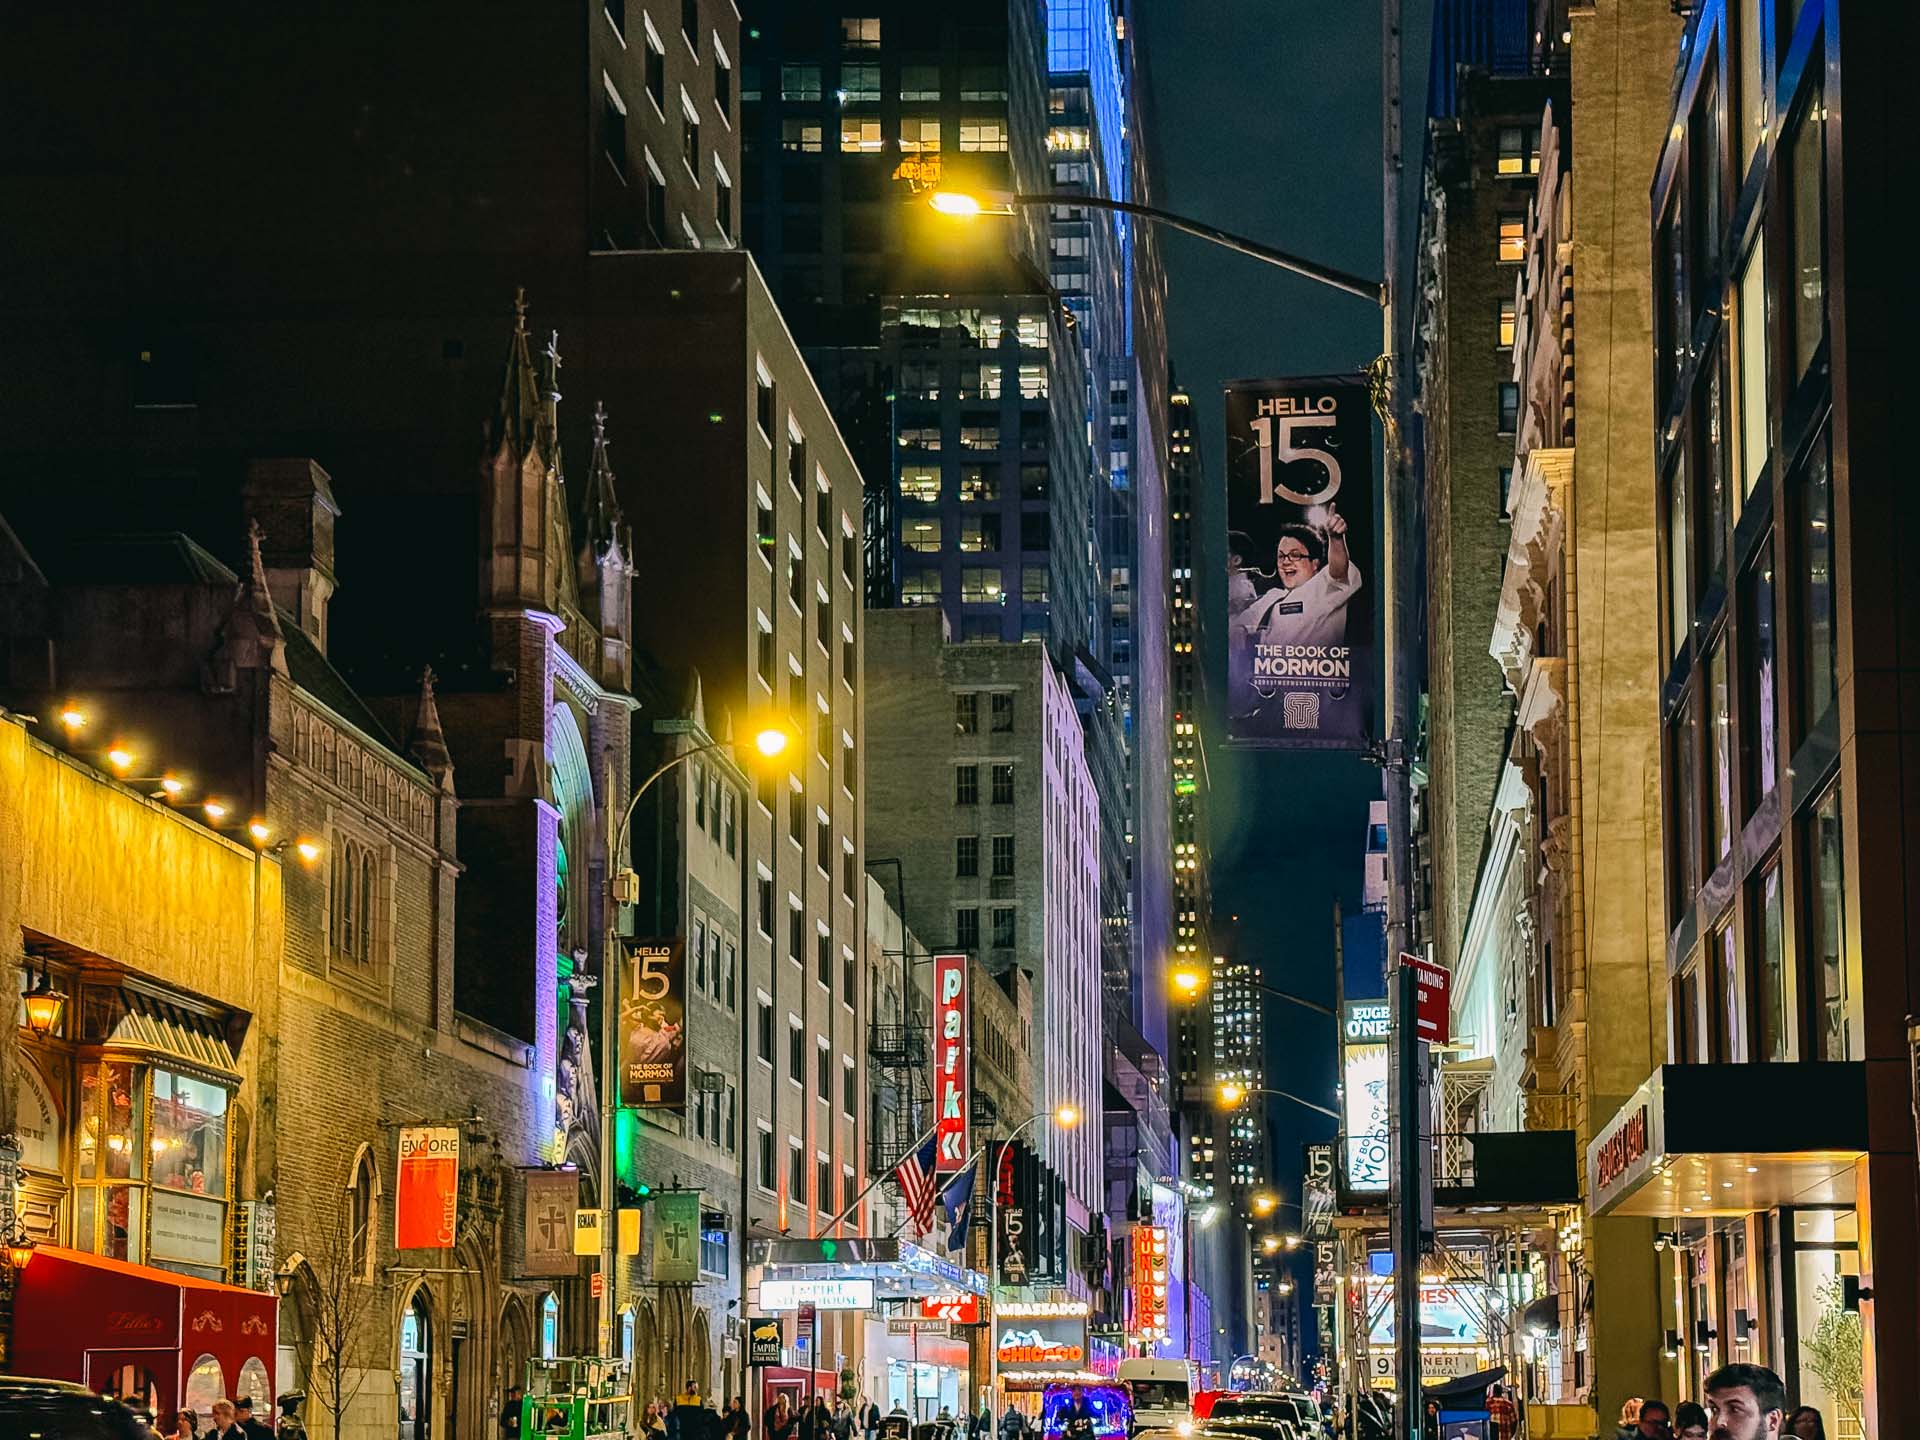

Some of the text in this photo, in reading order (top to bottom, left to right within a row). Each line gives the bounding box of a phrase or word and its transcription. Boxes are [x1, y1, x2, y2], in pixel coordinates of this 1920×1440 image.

[1258, 397, 1337, 416] HELLO
[1250, 415, 1342, 505] 15
[1255, 645, 1350, 659] THE BOOK OF
[1254, 658, 1350, 677] MORMON
[634, 947, 671, 956] HELLO
[630, 957, 671, 1001] 15
[1417, 989, 1428, 1004] me
[1352, 1007, 1391, 1020] EUGE
[943, 968, 963, 1120] park
[629, 1069, 673, 1079] MORMON
[402, 1139, 457, 1153] ENCORE
[1308, 1151, 1332, 1177] 15
[437, 1190, 456, 1244] Center
[1004, 1213, 1024, 1236] 15
[1317, 1246, 1334, 1264] 15
[1140, 1227, 1153, 1328] JUNIORS
[752, 1343, 780, 1352] EMPIRE
[998, 1346, 1083, 1362] CHICAGO
[1377, 1357, 1459, 1374] 9 NER!
[1422, 1367, 1459, 1375] USICAL
